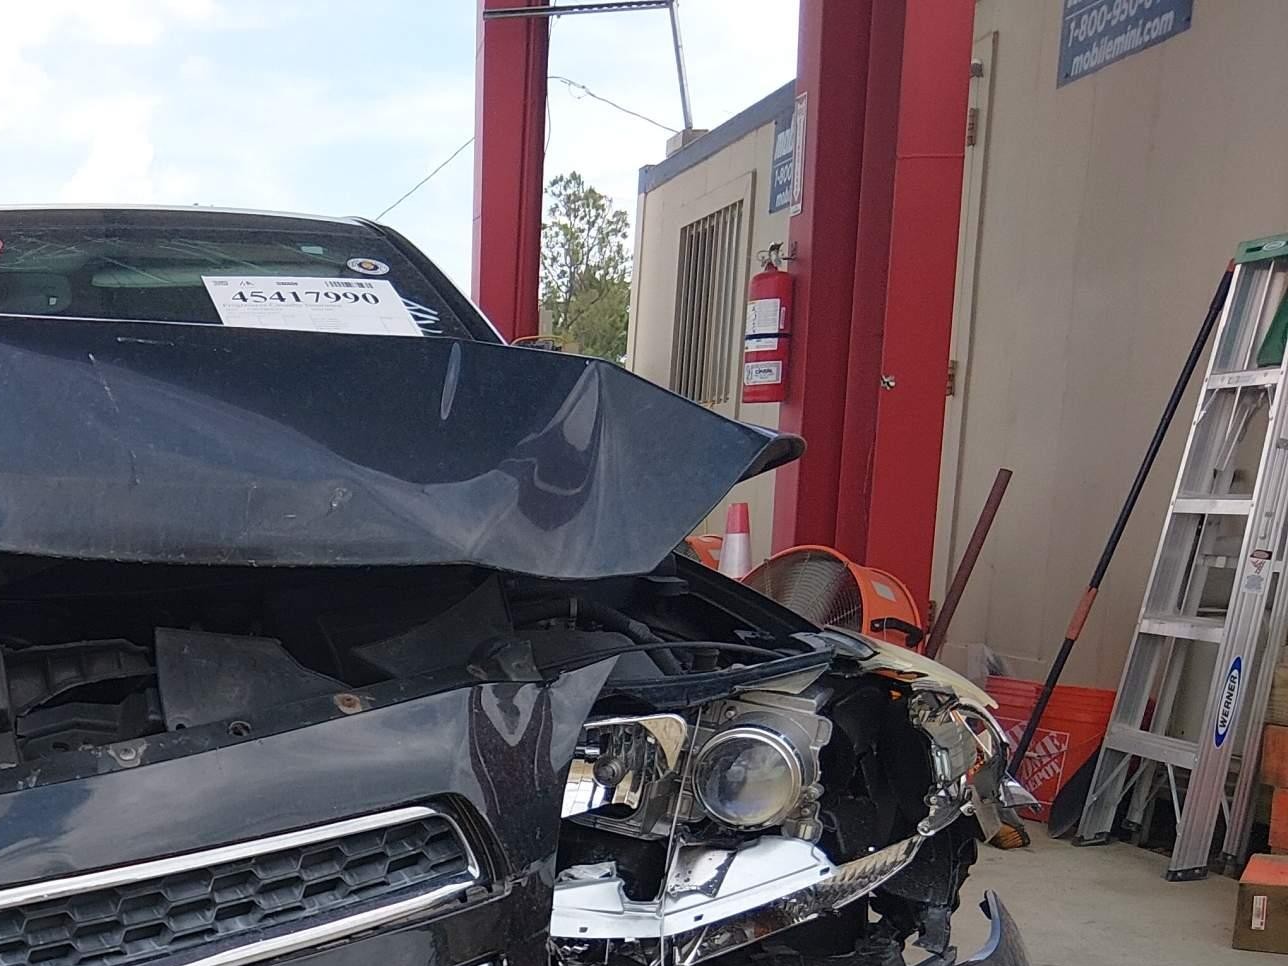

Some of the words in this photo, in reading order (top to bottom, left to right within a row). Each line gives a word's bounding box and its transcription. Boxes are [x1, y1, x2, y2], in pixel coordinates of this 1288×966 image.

[1071, 10, 1175, 76] mobilemini.com
[231, 290, 380, 305] 45417990
[1219, 675, 1237, 728] WERNER
